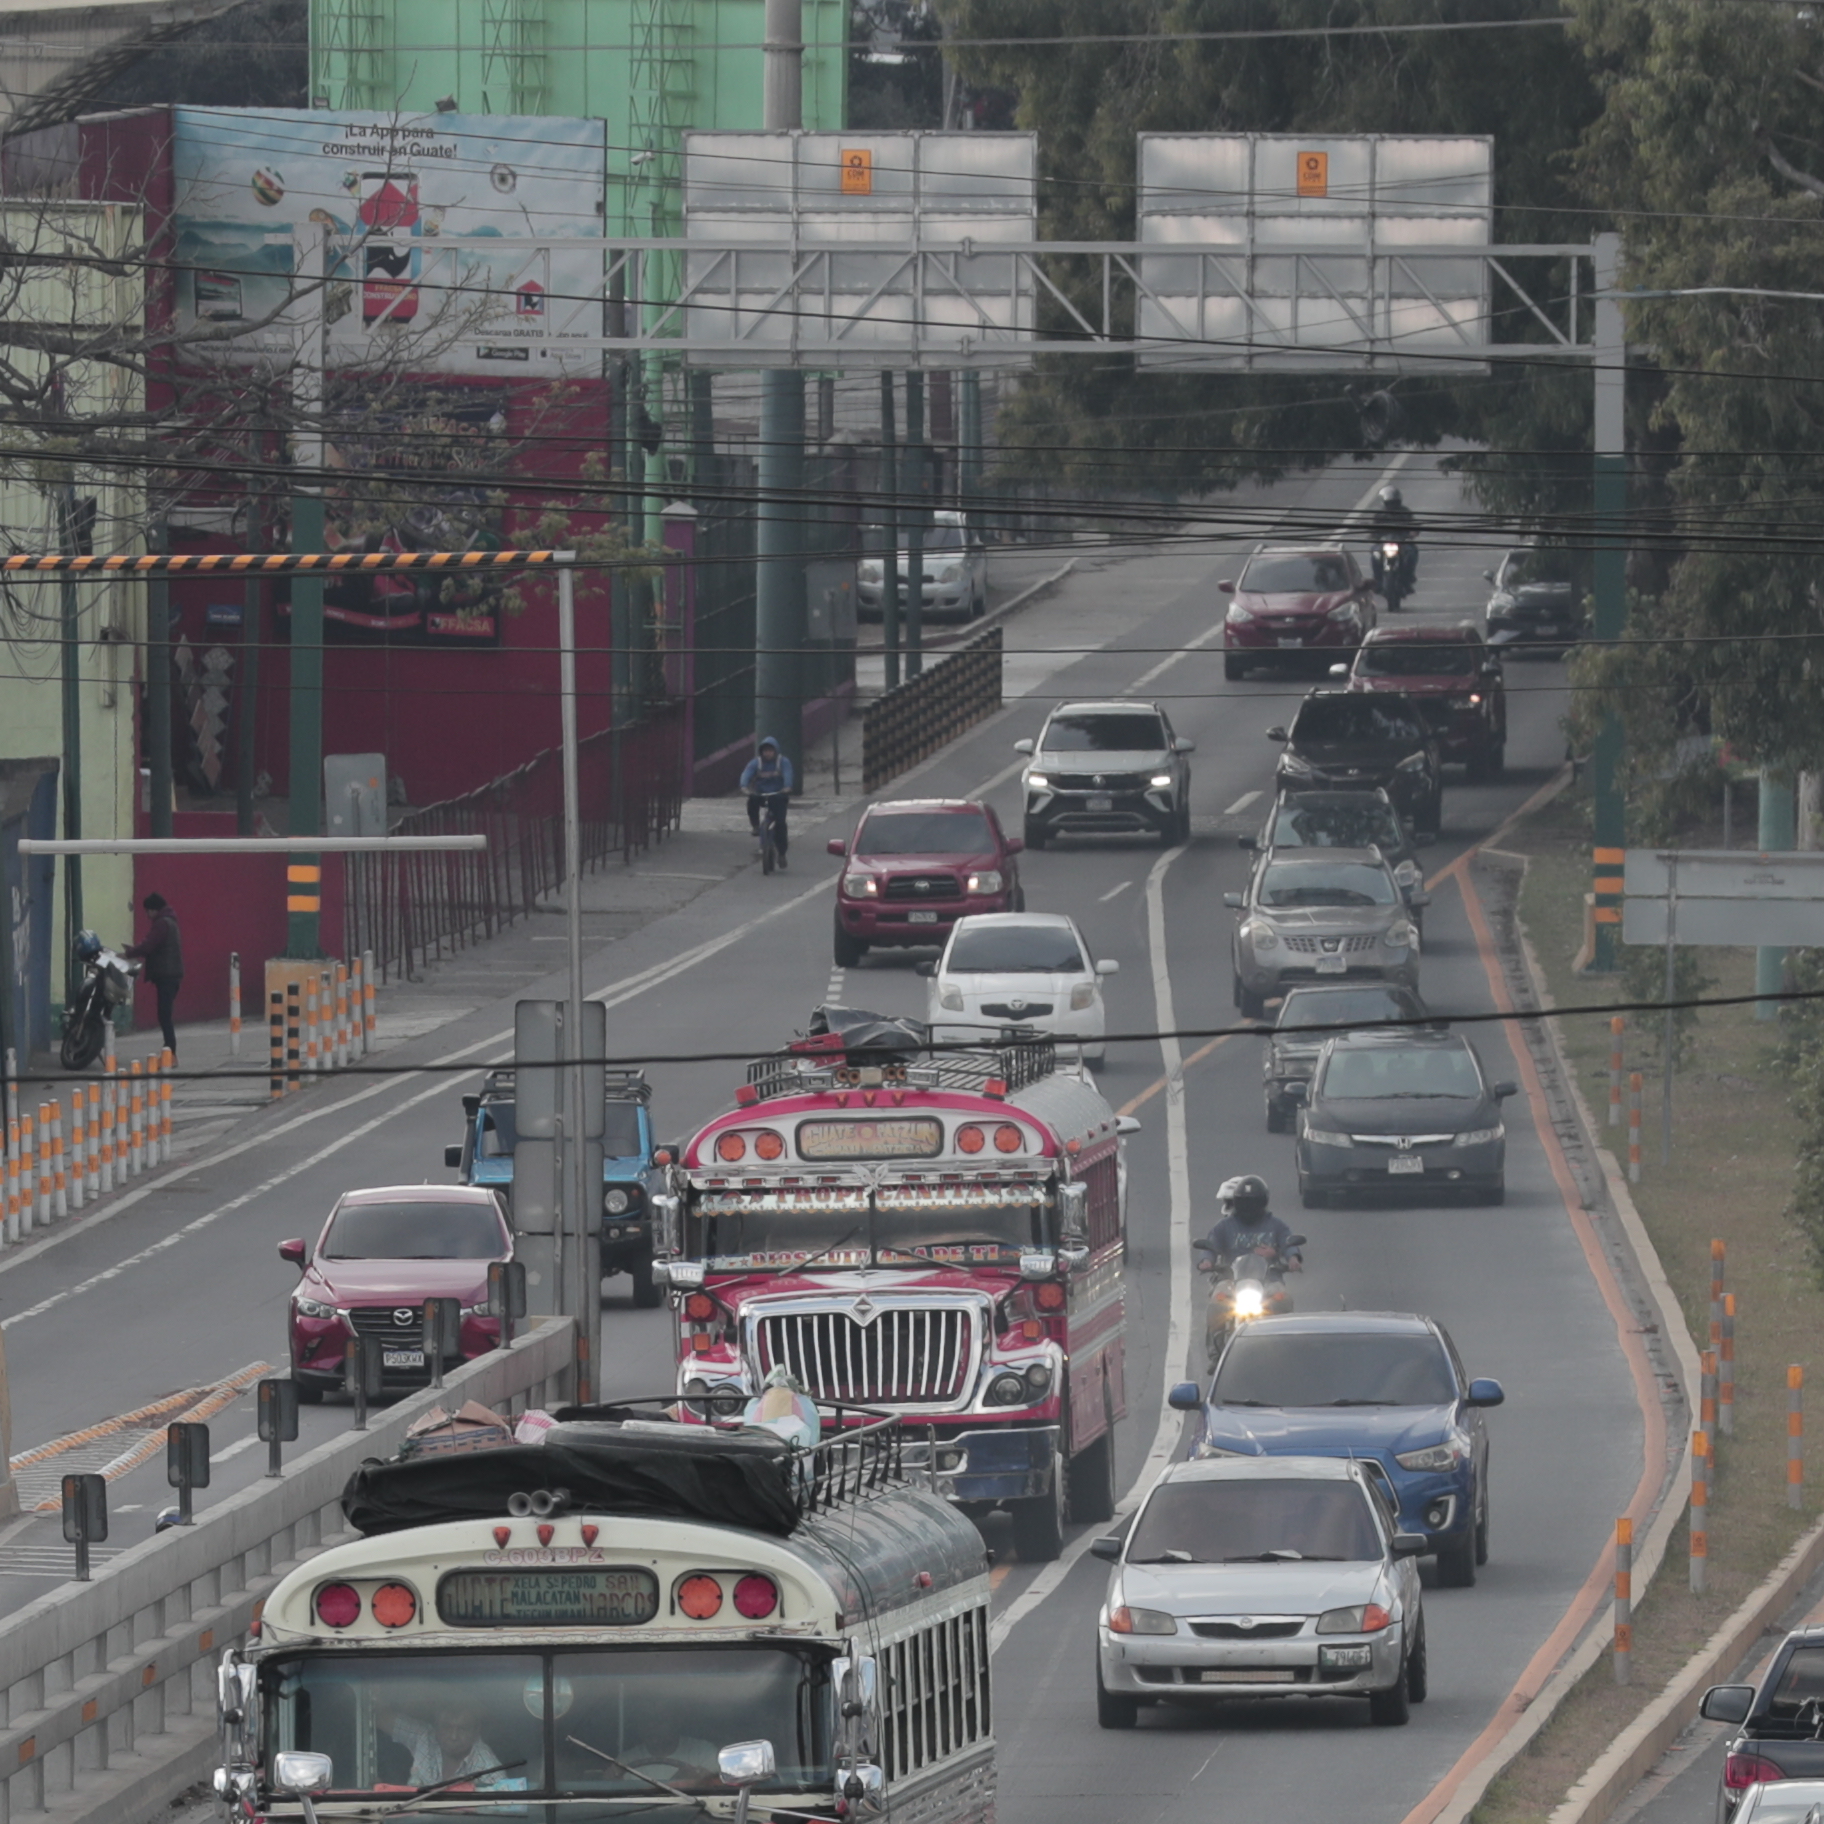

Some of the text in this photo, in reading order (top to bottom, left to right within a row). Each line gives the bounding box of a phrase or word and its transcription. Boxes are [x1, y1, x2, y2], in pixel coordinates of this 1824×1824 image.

[403, 128, 434, 143] para
[322, 141, 385, 156] construir
[410, 142, 457, 158] Guate!
[513, 329, 544, 338] GRATIS
[810, 1124, 856, 1146] GUATE
[750, 1250, 808, 1267] DIOS
[932, 1246, 965, 1262] DE
[970, 1245, 999, 1261] TI
[482, 1546, 605, 1567] C-603BPZ
[513, 1577, 541, 1589] XELA
[560, 1575, 597, 1590] PEDRO
[511, 1590, 582, 1606] MALACATAN
